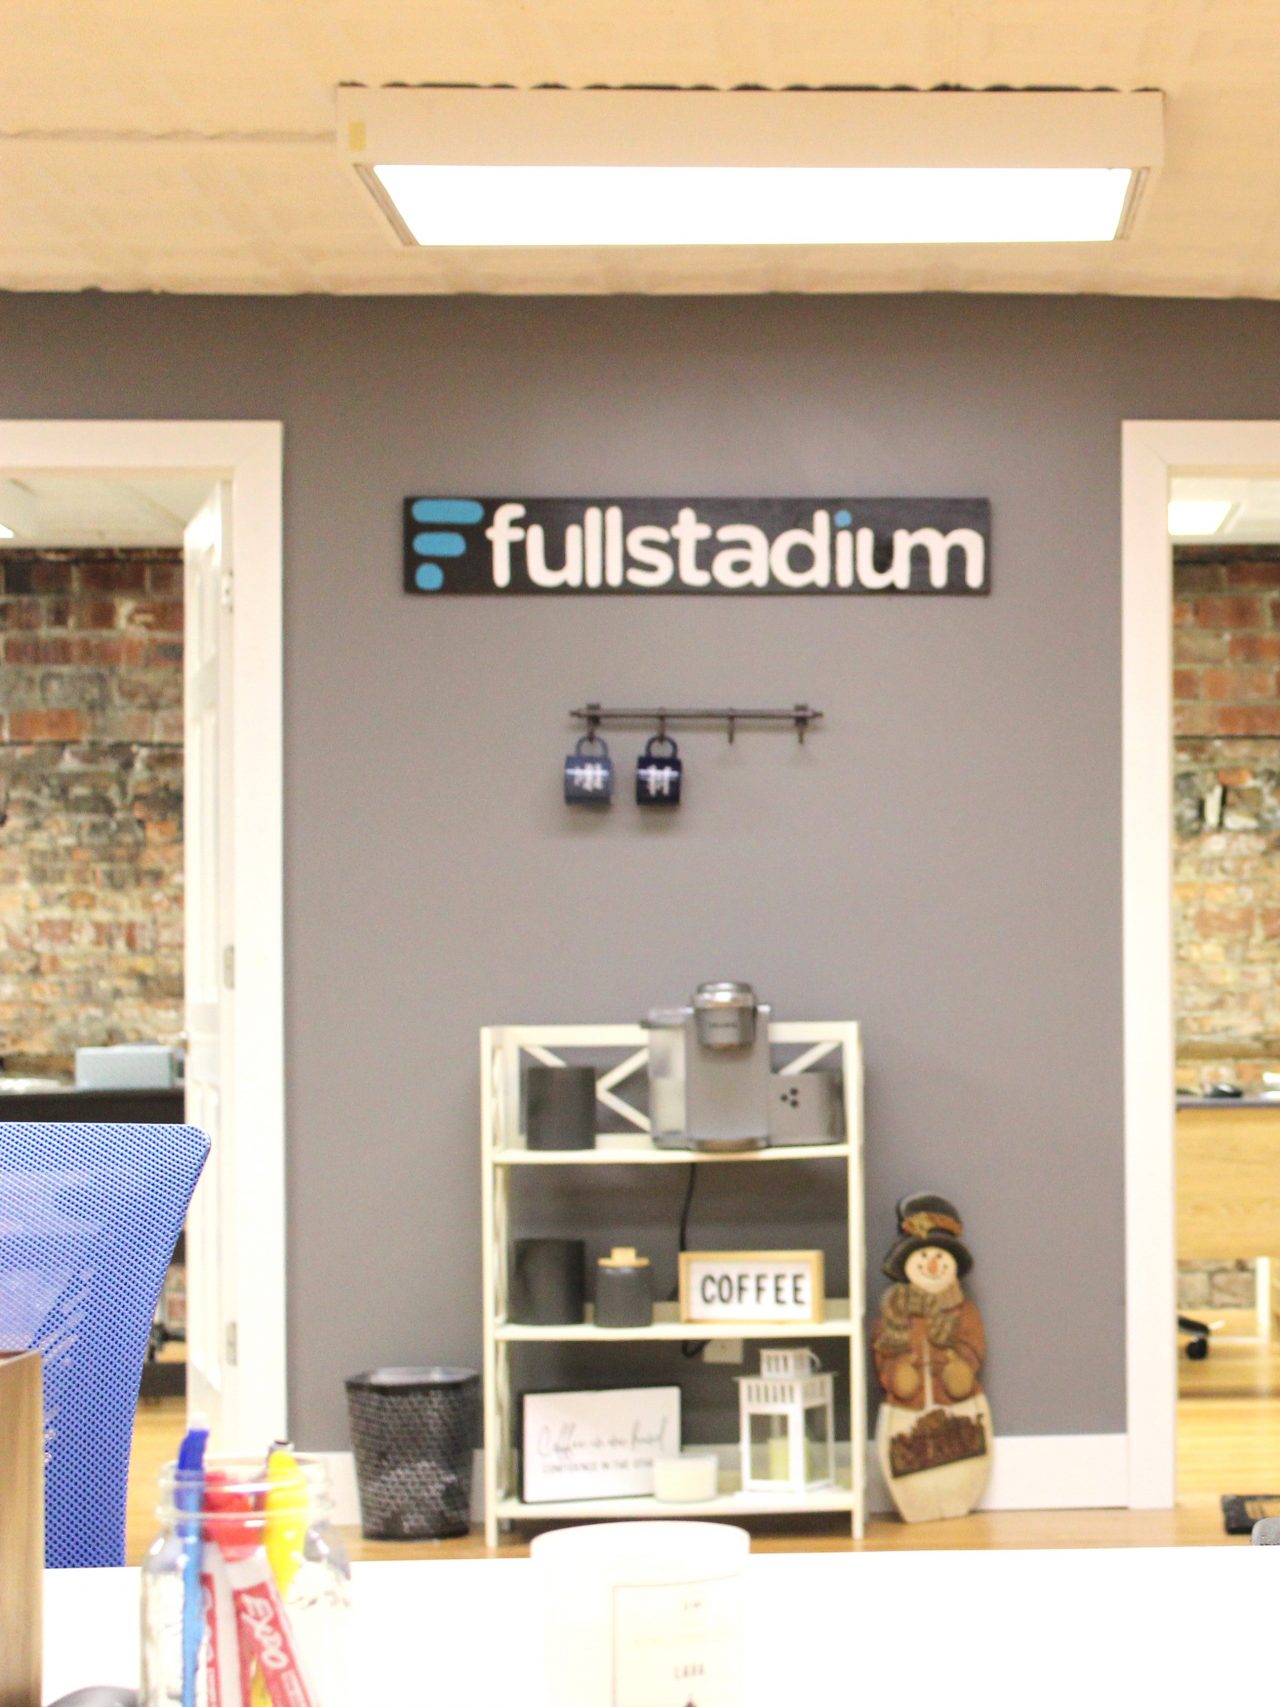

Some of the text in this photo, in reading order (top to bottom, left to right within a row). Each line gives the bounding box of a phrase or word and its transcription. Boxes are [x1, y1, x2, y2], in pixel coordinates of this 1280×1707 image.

[485, 502, 986, 589] fullstadium
[701, 1273, 806, 1305] COFFEE
[240, 1593, 290, 1670] EXPO
